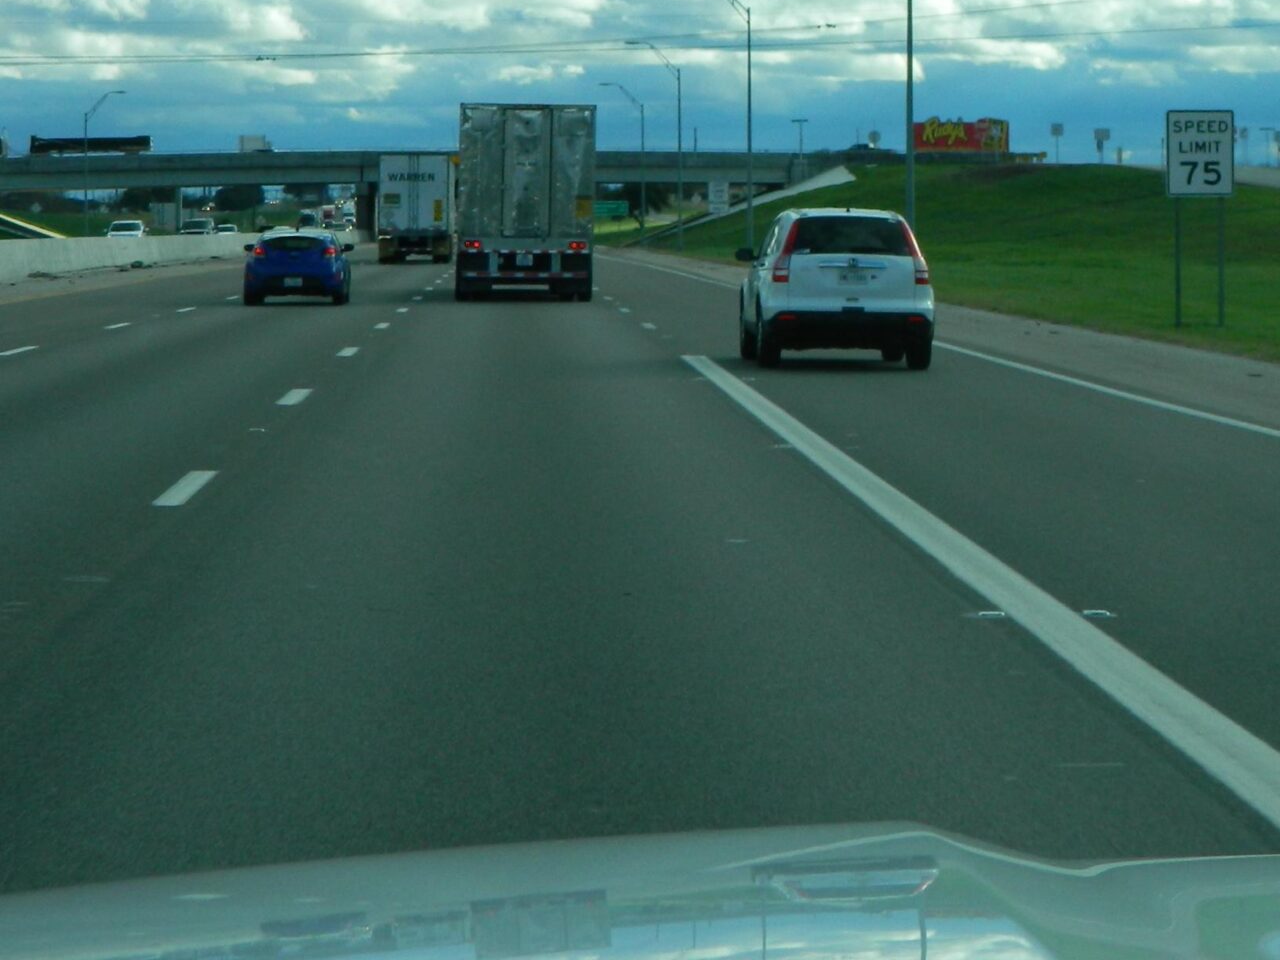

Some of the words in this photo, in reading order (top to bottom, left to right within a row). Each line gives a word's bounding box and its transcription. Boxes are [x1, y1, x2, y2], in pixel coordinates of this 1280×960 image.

[922, 116, 968, 145] Rudy's
[1172, 120, 1229, 133] SPEED
[1178, 140, 1222, 154] LIMIT
[387, 172, 435, 182] WARREN
[1179, 160, 1222, 186] 75
